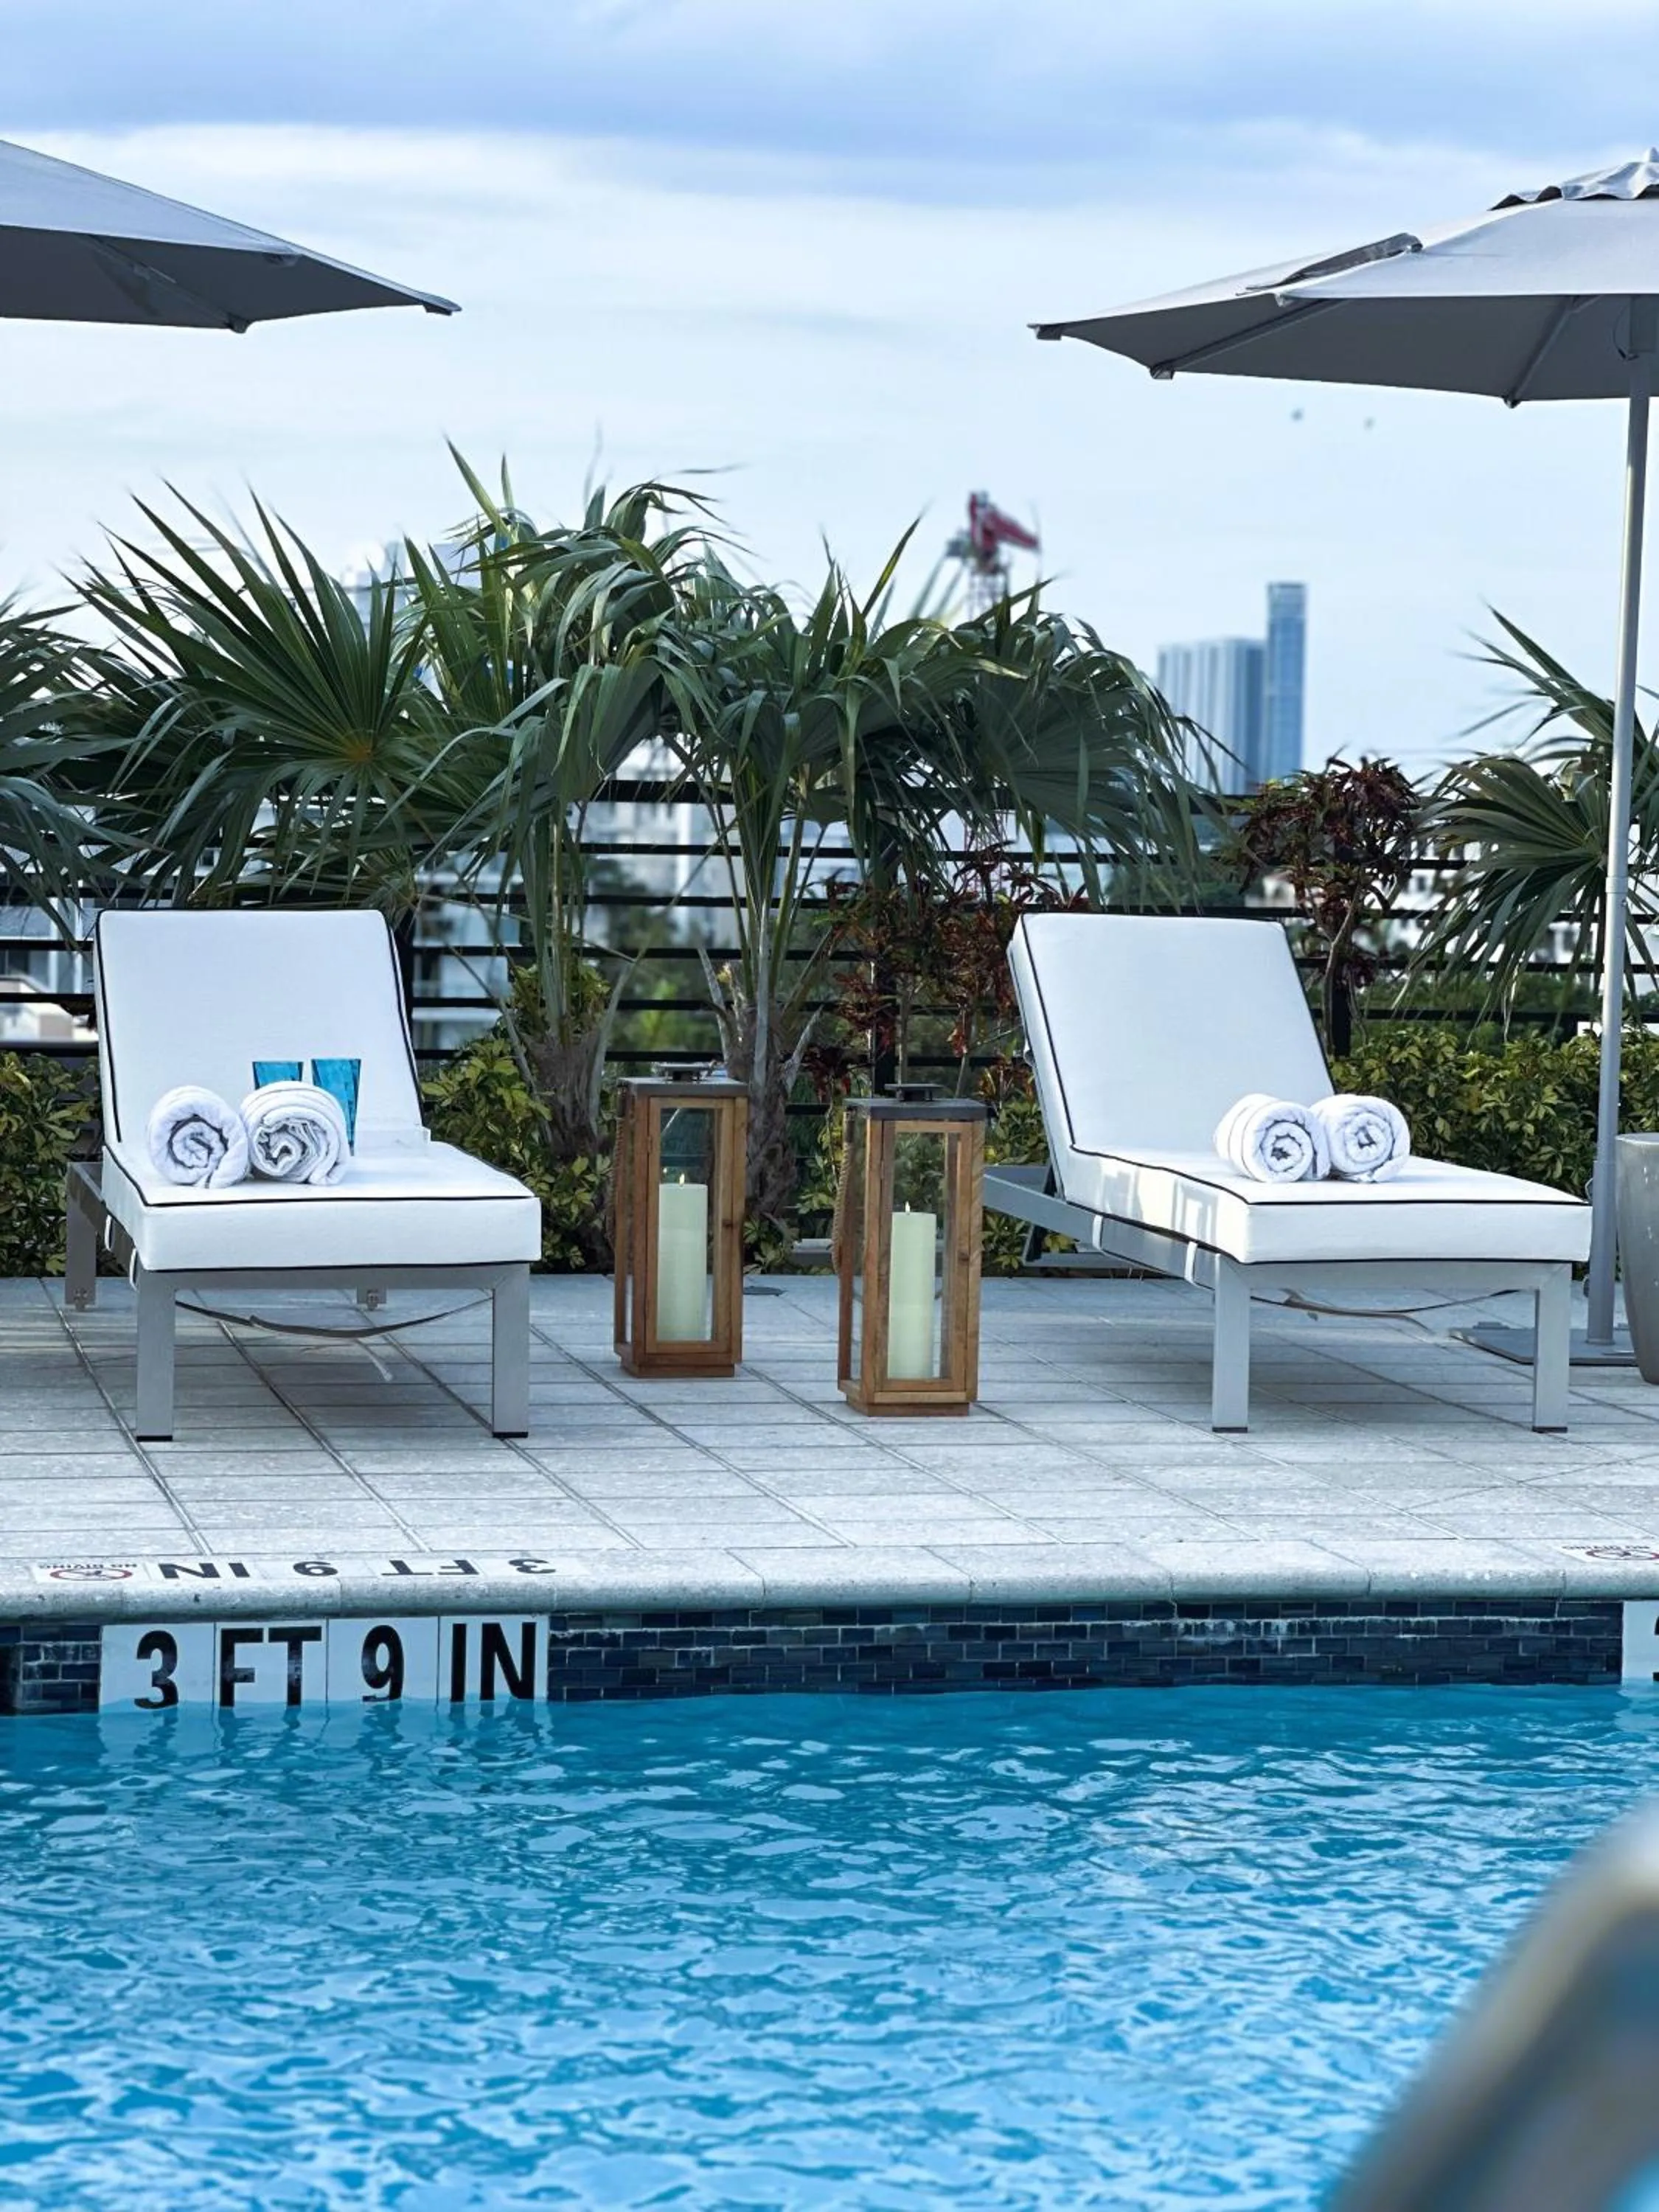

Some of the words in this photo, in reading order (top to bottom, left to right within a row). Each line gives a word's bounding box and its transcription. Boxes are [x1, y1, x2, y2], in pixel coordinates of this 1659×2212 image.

[158, 1562, 250, 1579] IN
[293, 1561, 338, 1576] 9
[382, 1559, 479, 1576] FT
[509, 1559, 556, 1574] 3
[133, 1630, 179, 1710] 3
[220, 1627, 322, 1707] FT
[361, 1624, 404, 1702] 9
[450, 1621, 537, 1703] IN
